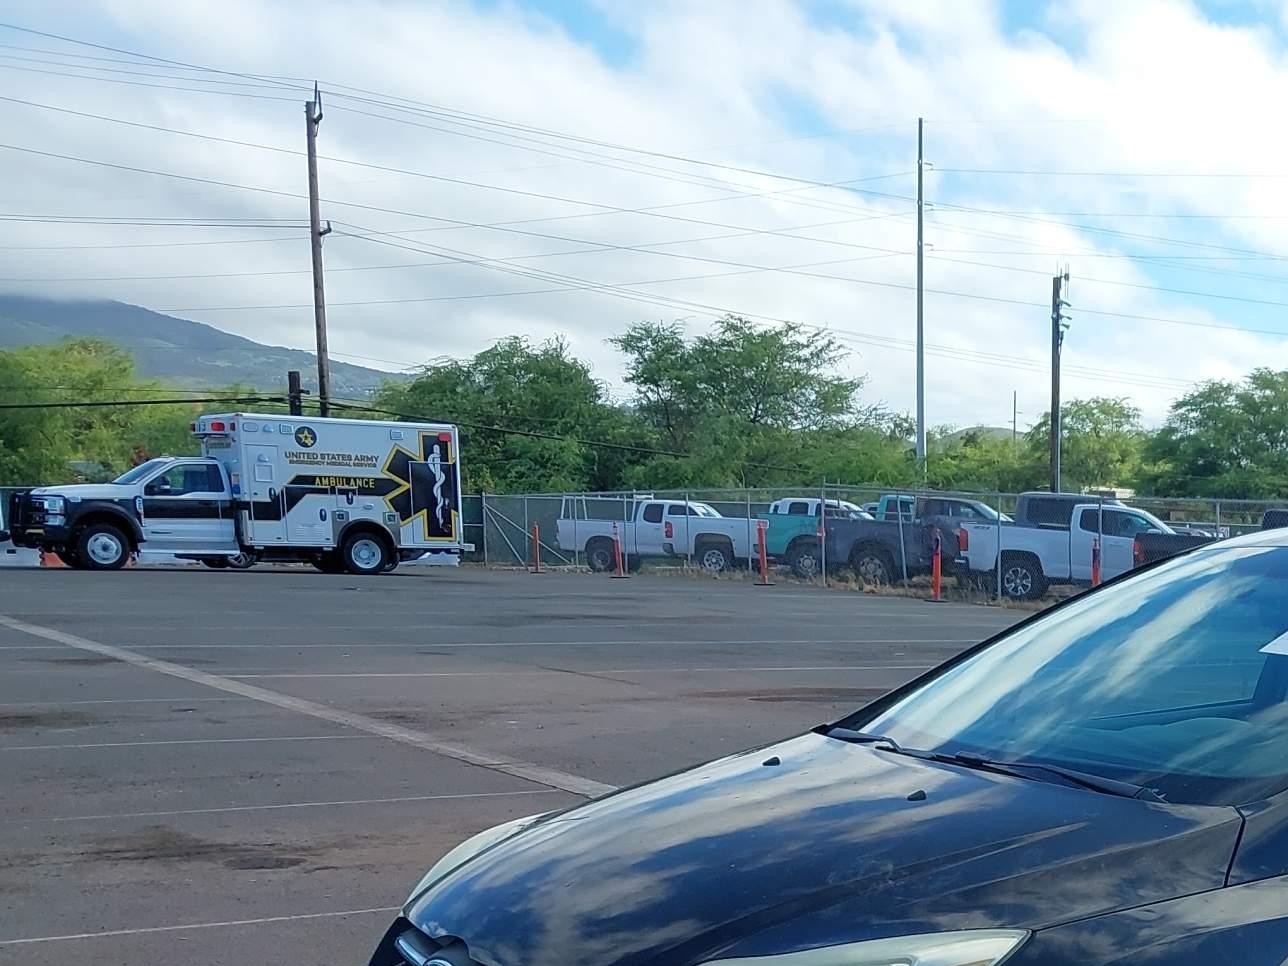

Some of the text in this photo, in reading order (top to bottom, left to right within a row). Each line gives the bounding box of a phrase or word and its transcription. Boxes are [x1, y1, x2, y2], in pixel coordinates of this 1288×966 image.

[284, 451, 379, 462] UNITED STATES ARMY
[315, 476, 376, 488] AMBULANCE
